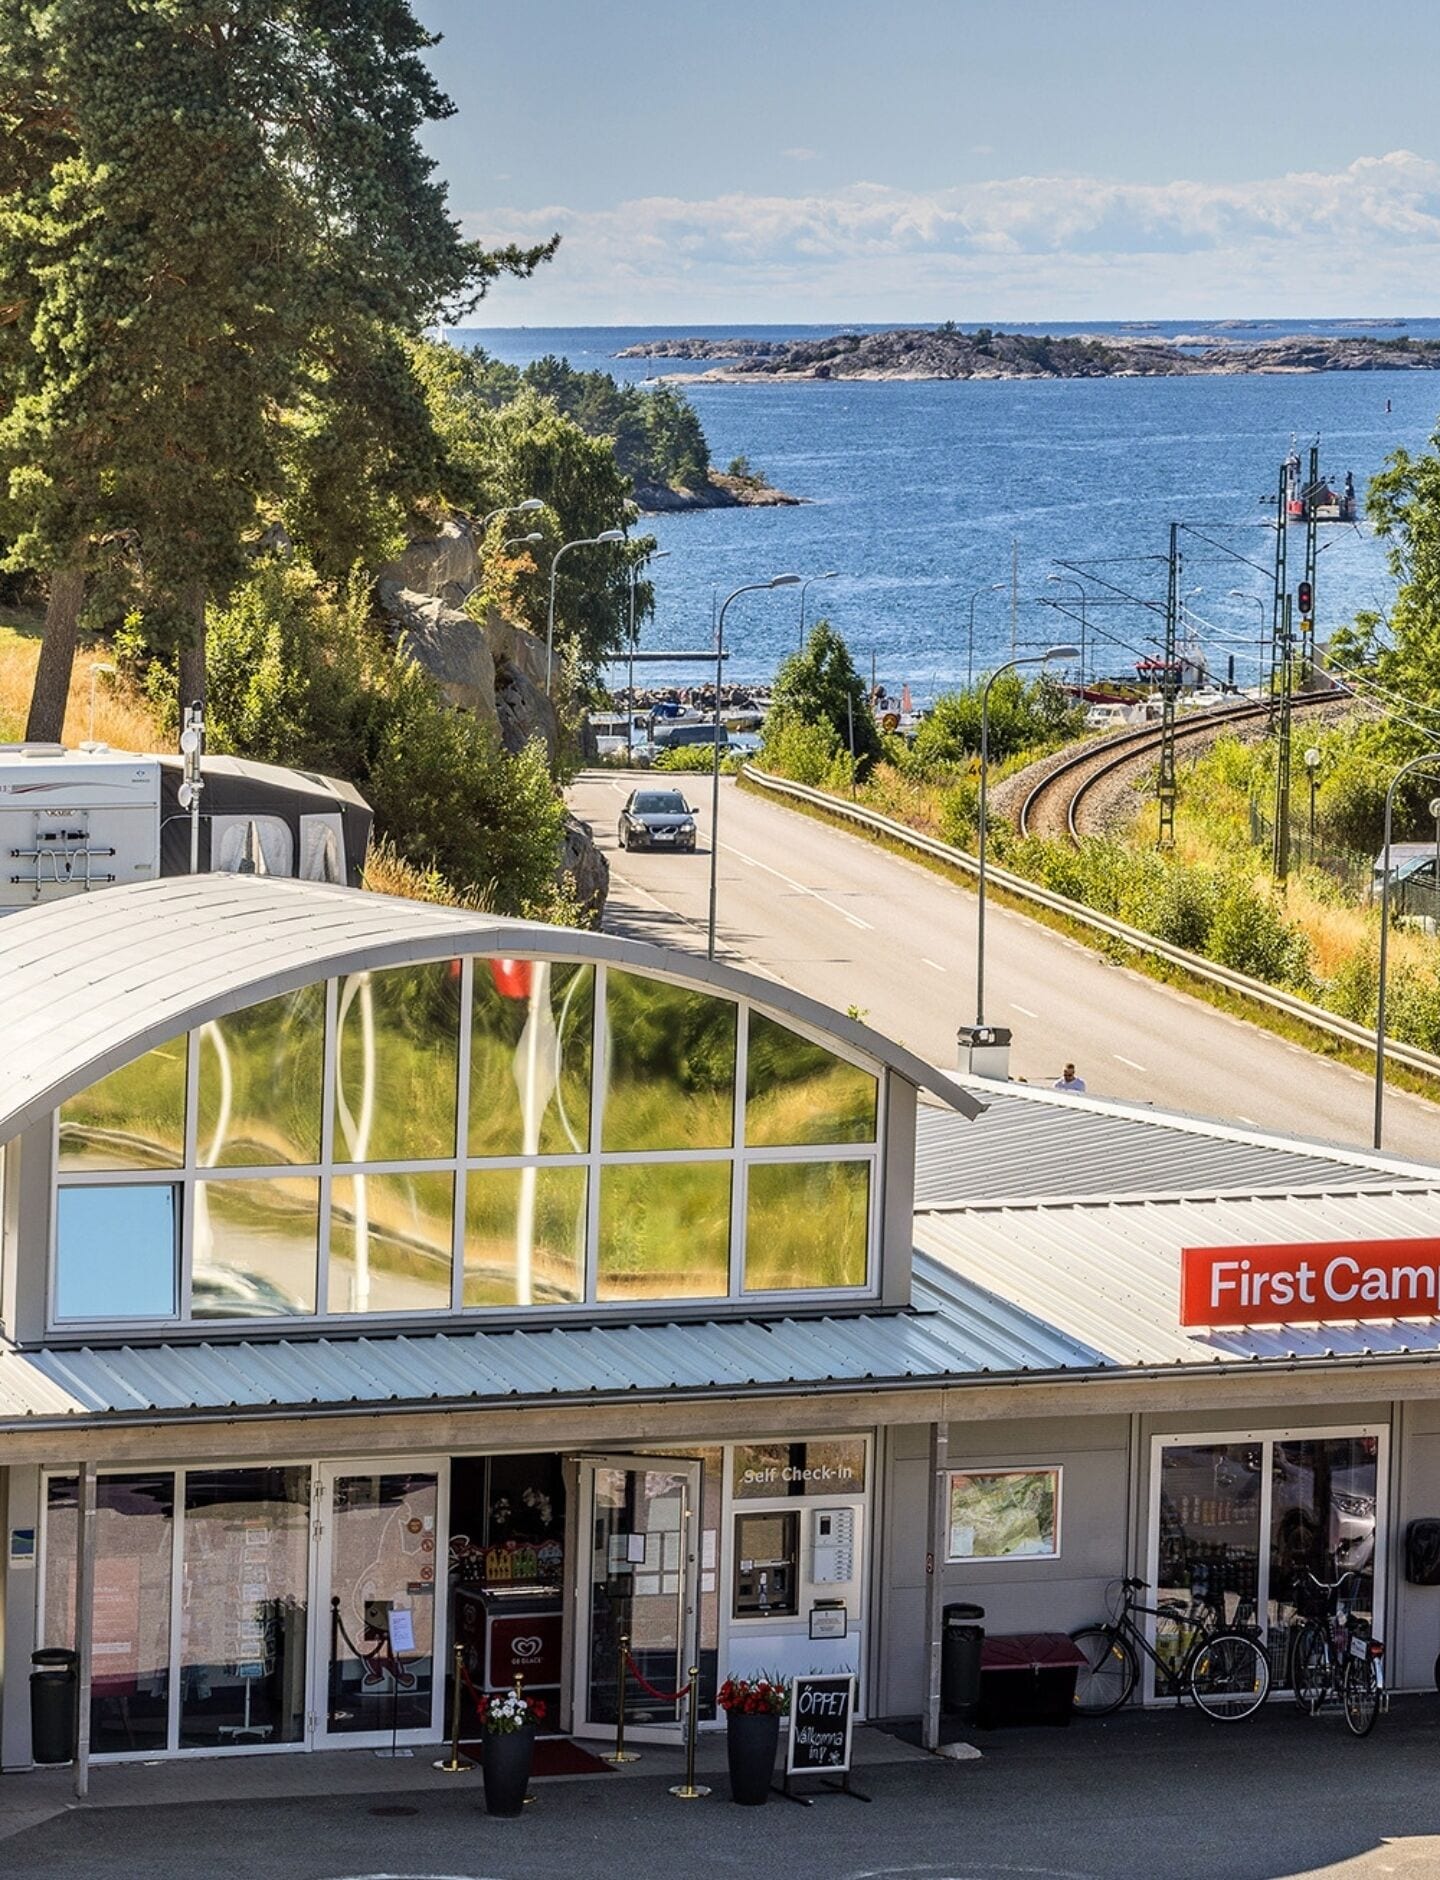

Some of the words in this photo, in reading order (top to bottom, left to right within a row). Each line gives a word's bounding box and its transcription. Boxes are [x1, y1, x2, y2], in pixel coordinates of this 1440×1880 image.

[1210, 1259, 1316, 1308] First
[743, 1468, 776, 1483] Self
[782, 1465, 852, 1481] Check-in
[799, 1685, 847, 1716] ÖPPET
